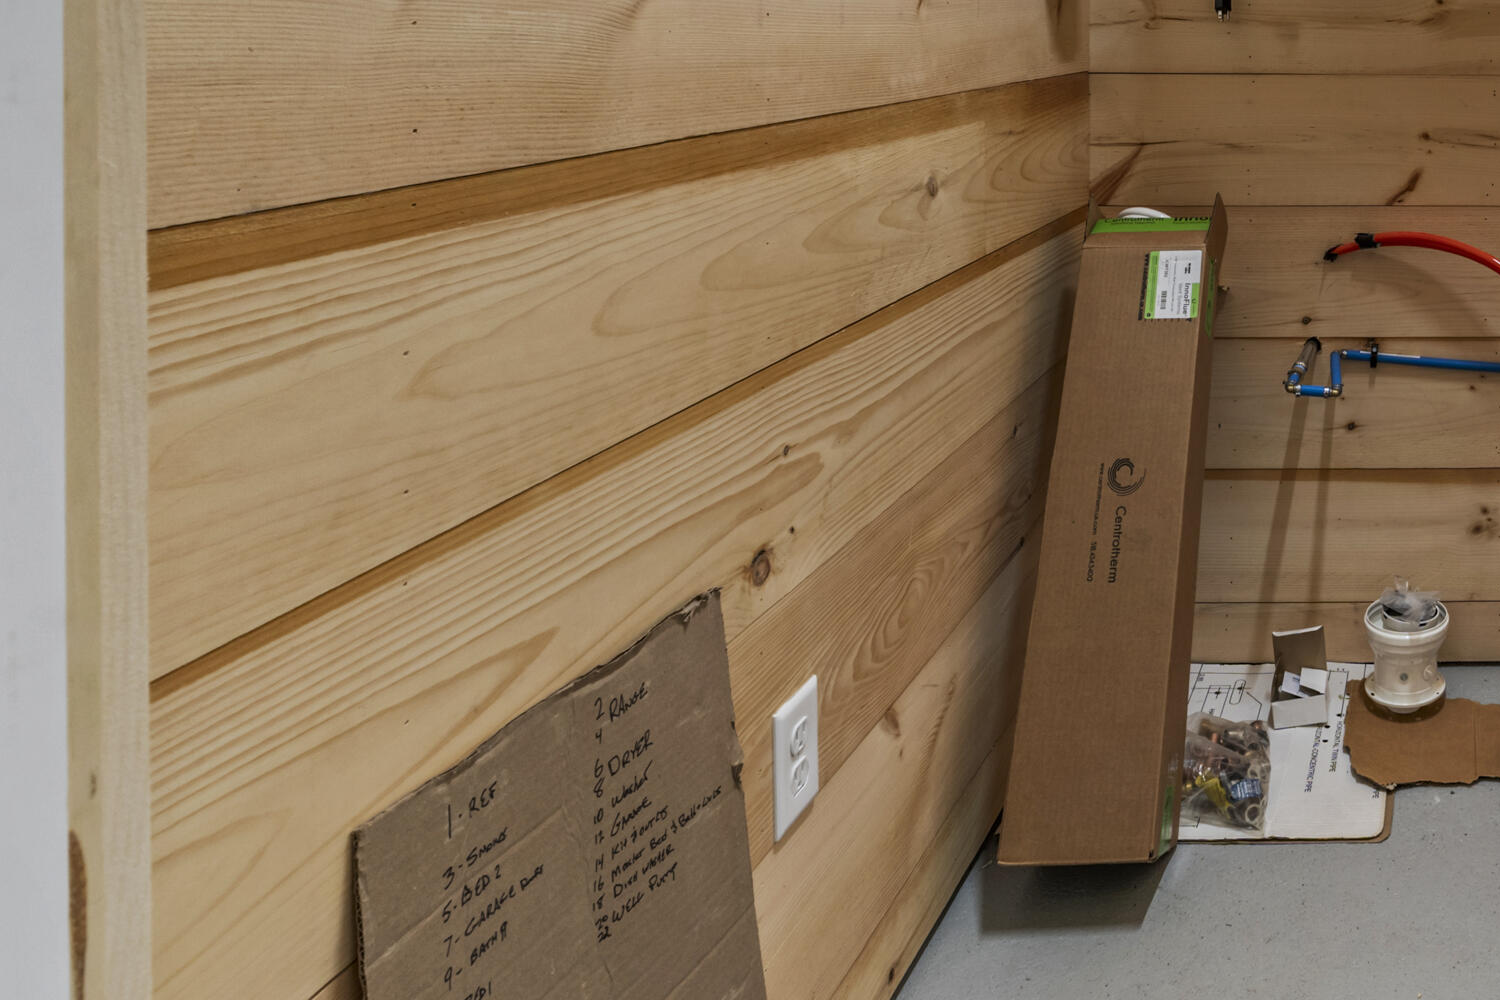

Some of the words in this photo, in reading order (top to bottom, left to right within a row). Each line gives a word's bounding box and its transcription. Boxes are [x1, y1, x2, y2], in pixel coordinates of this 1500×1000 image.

[1108, 505, 1127, 584] Centrotherm
[594, 758, 604, 778] 6
[608, 729, 653, 776] DRYER
